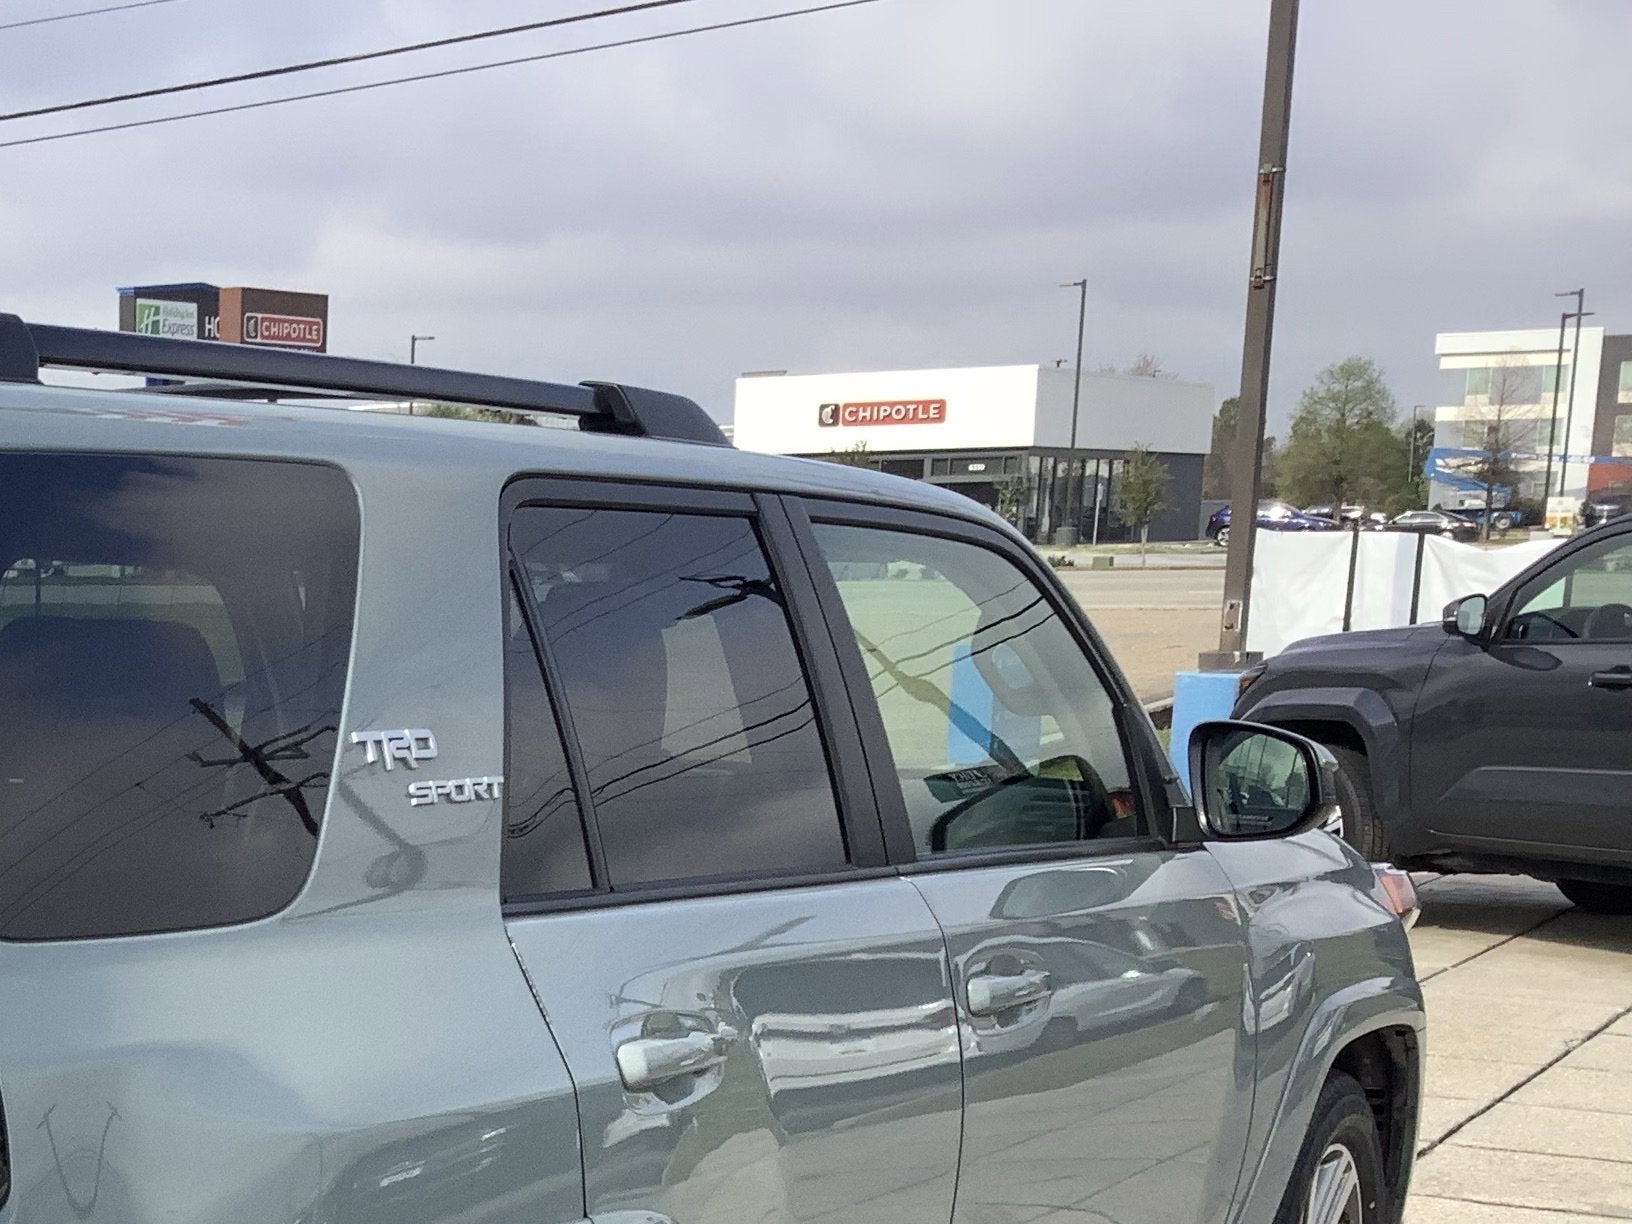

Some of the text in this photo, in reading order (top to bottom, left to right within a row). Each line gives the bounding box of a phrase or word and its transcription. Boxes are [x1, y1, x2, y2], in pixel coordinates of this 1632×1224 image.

[261, 321, 318, 340] CHIPOTLE
[844, 403, 942, 422] CHIPOTLE
[351, 728, 438, 771] TRD
[408, 776, 504, 806] SPORT
